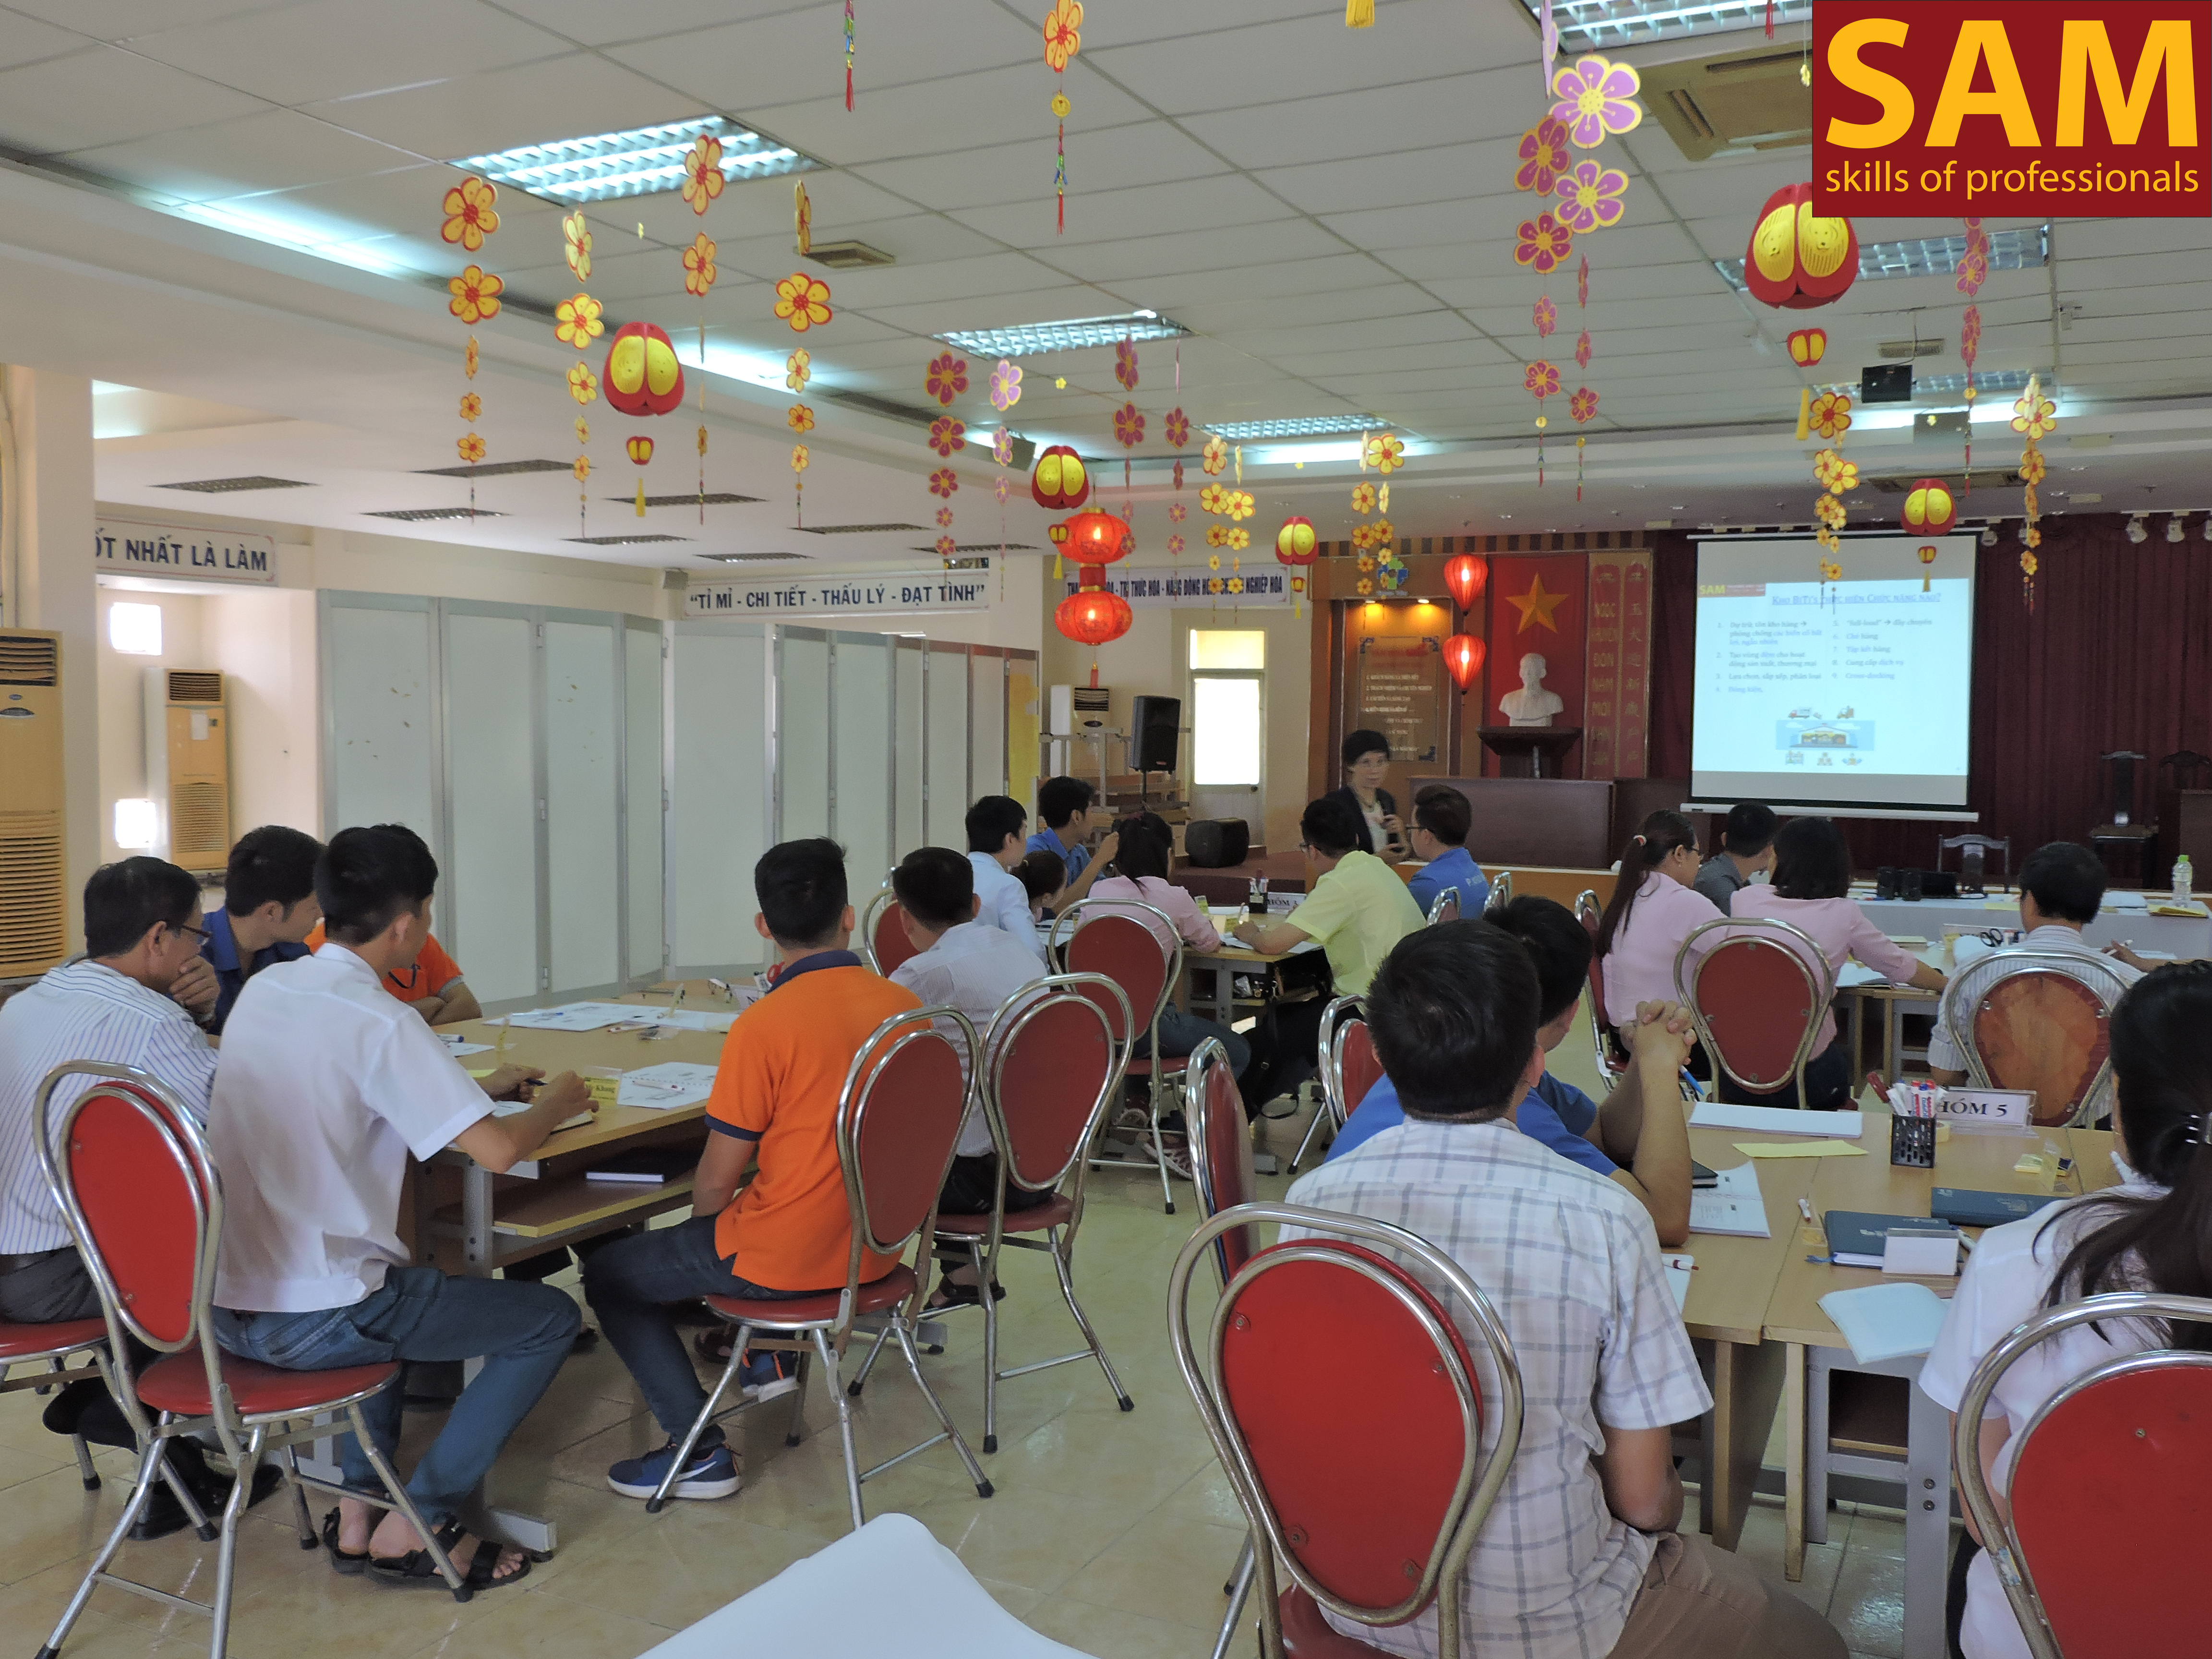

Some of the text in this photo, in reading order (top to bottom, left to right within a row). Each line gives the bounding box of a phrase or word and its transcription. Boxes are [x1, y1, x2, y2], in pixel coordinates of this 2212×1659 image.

[126, 535, 182, 564] NHẤT
[192, 541, 216, 567] LÀ
[225, 543, 266, 571] LÀM
[746, 592, 769, 607] CHI
[774, 584, 806, 606] TIẾT
[821, 583, 861, 605] THẤU
[902, 586, 933, 606] ĐẠT
[1699, 584, 1725, 595] SAM
[1996, 1104, 2008, 1117] 5
